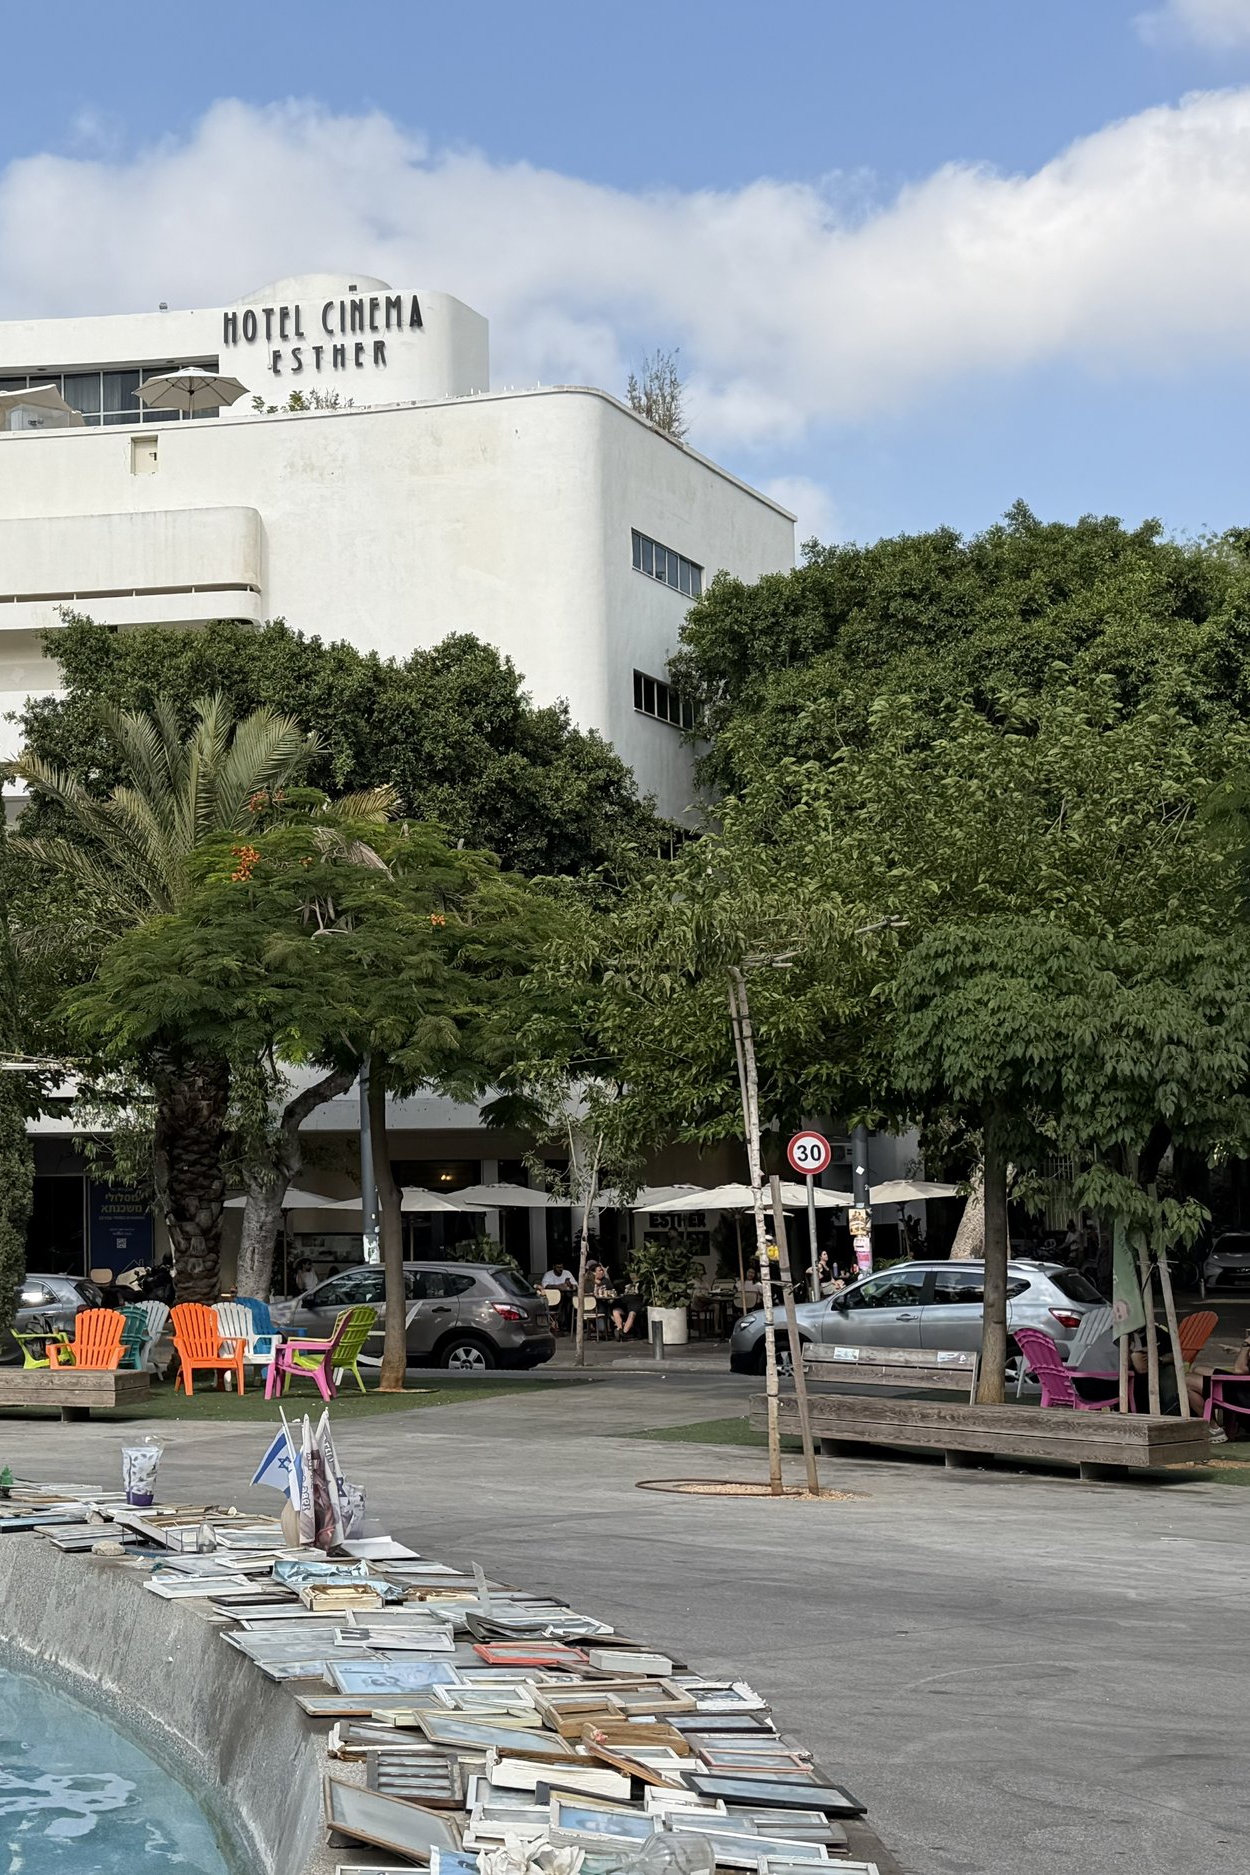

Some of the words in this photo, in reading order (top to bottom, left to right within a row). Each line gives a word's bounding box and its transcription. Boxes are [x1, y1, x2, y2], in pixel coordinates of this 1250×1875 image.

[223, 304, 304, 344] HOTEL
[321, 295, 423, 334] CINEMA
[272, 340, 386, 373] ESTHER
[797, 1144, 822, 1162] 30
[101, 1204, 143, 1213] משכנתא
[649, 1213, 706, 1228] ESTHER
